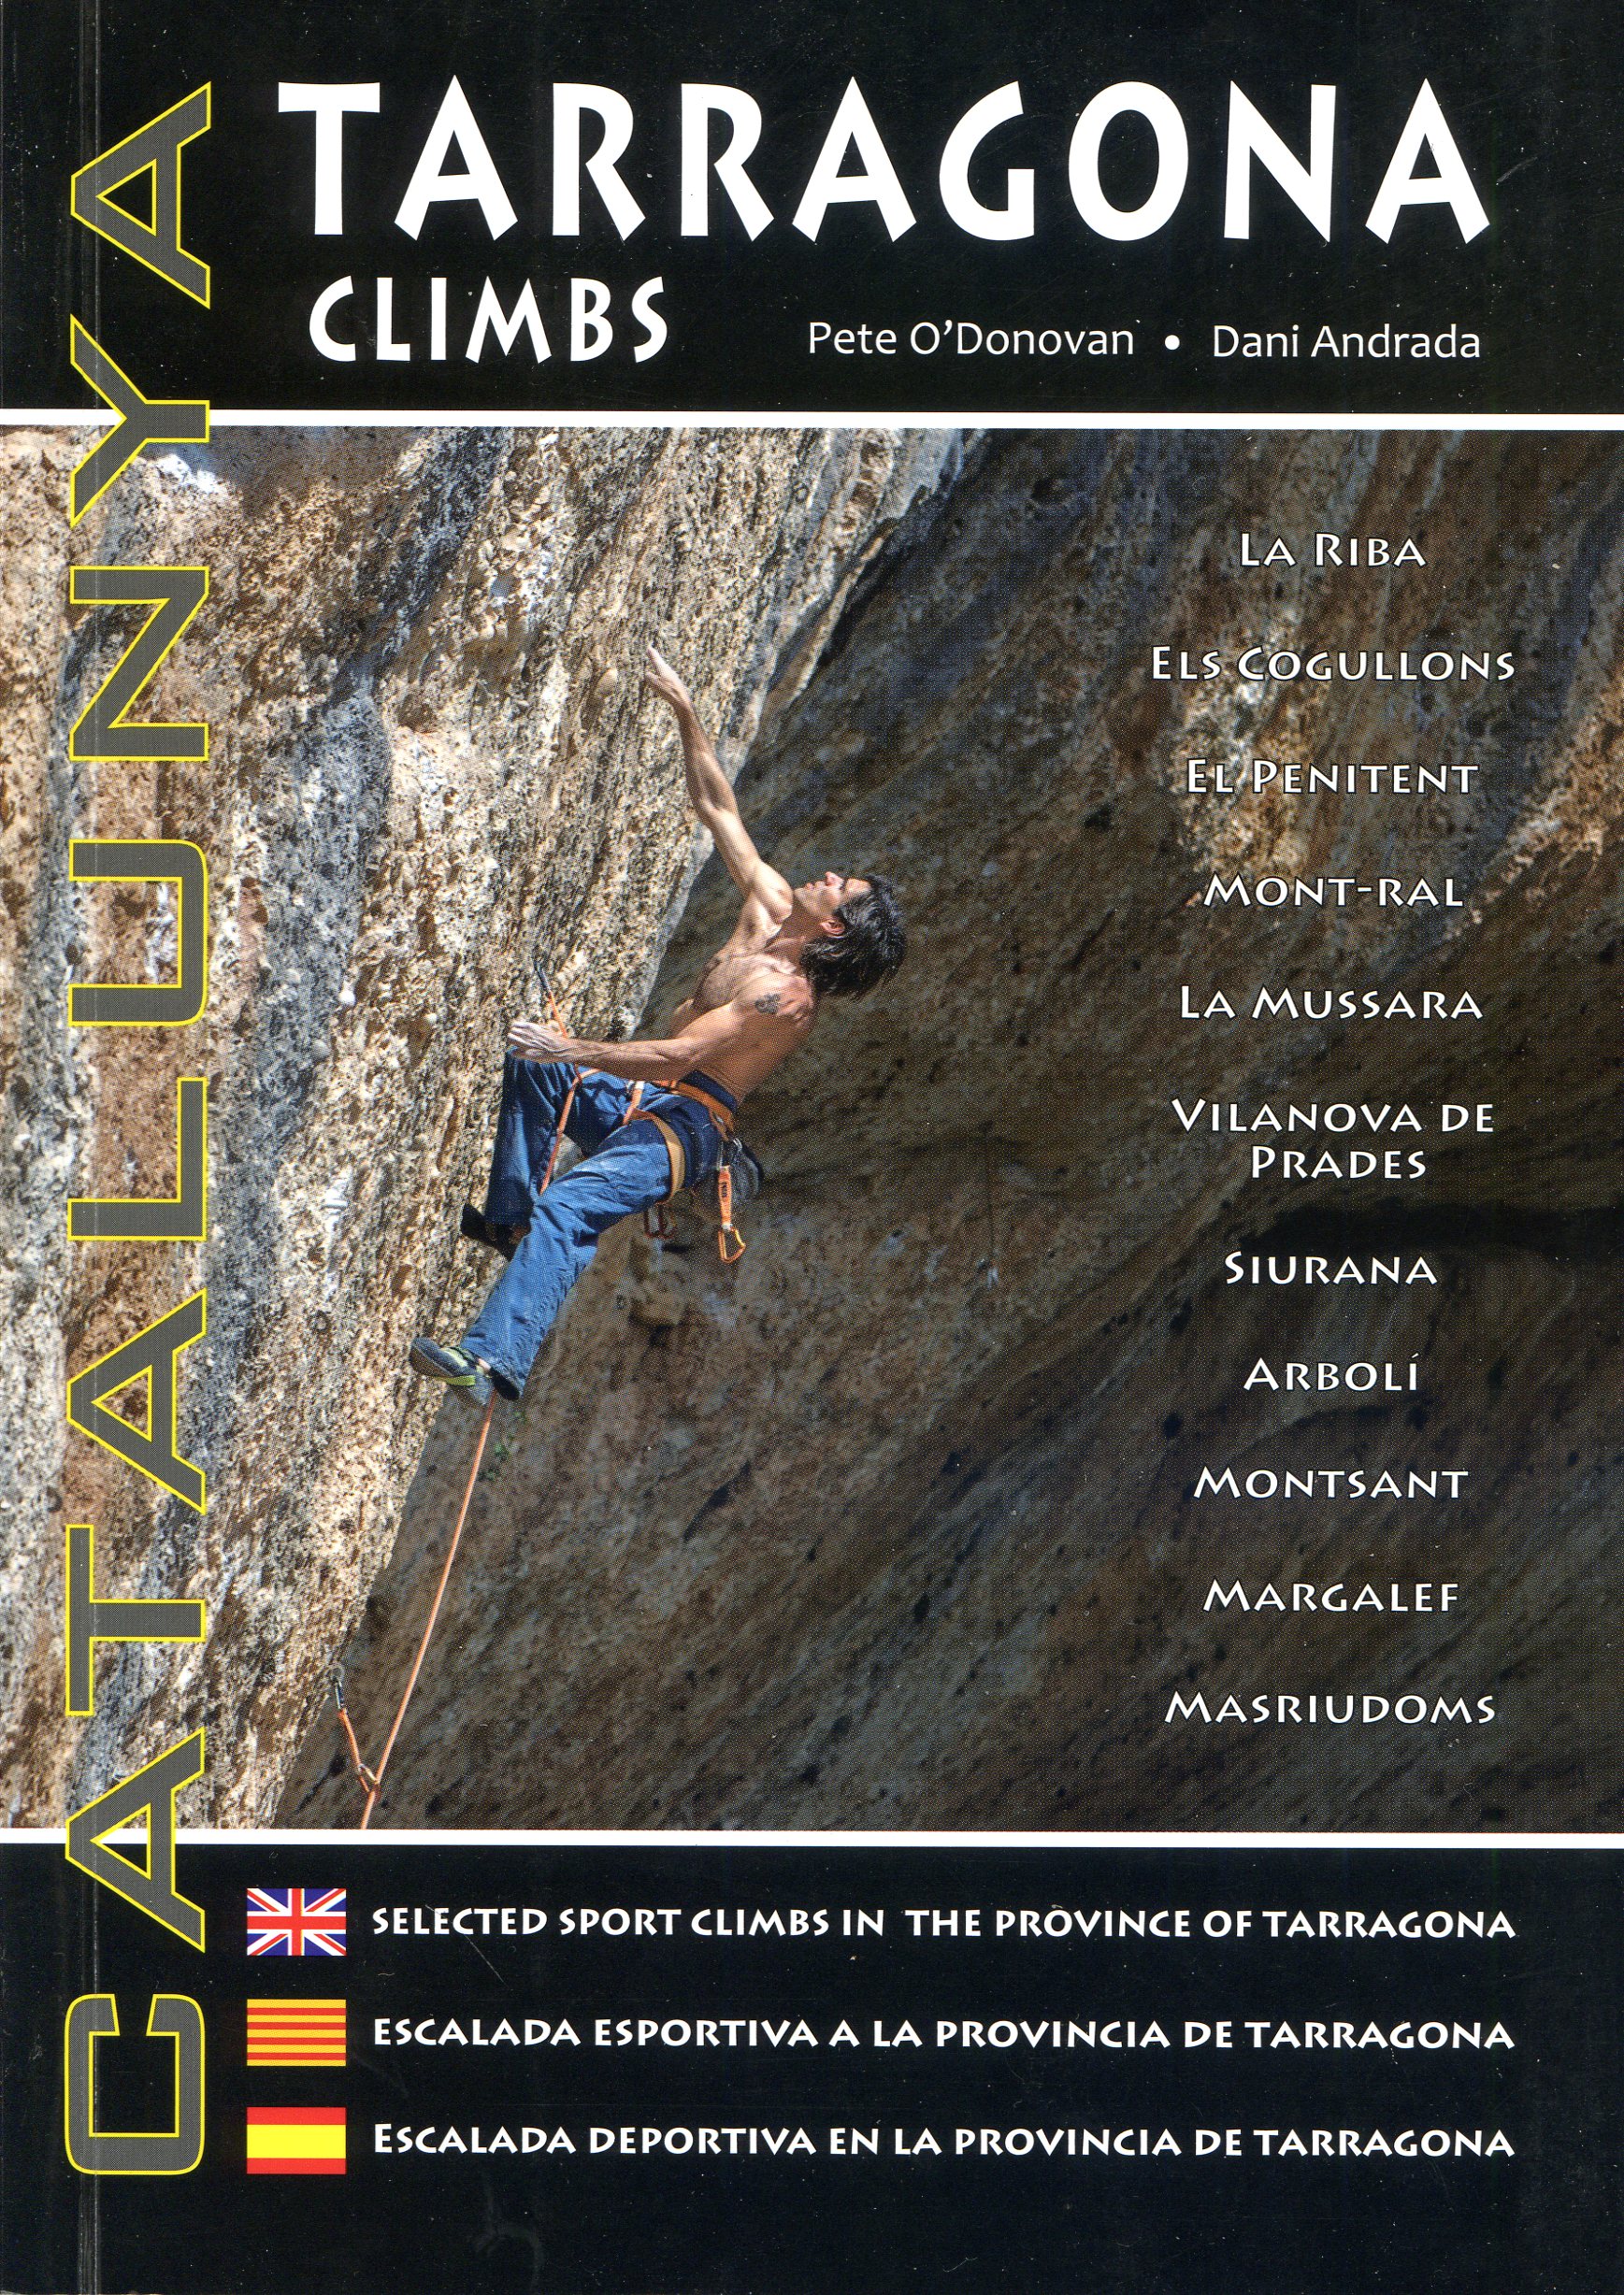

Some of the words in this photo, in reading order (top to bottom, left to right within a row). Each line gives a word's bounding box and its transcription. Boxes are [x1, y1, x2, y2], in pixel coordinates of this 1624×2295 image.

[278, 74, 1490, 244] TARRAGONA
[309, 275, 668, 364] CLIMBS
[810, 322, 897, 354] Pete
[910, 319, 1133, 355] O’Donovan
[1214, 325, 1298, 358] Dani
[1310, 323, 1480, 358] Andrada
[1242, 533, 1296, 567] LA
[1315, 533, 1426, 567] RIBA
[1153, 646, 1220, 680] ELS
[1238, 646, 1516, 681] COGULLONS
[1187, 758, 1236, 793] EL
[1254, 760, 1478, 794] PENITENT
[1203, 874, 1463, 907] MONT-RAL
[1181, 985, 1236, 1019] LA
[1252, 987, 1483, 1019] MUSSARA
[65, 82, 210, 2174] CATALUNYA
[1171, 1098, 1422, 1132] VILANOVA
[1442, 1104, 1493, 1132] DE
[1252, 1145, 1426, 1179] PRADES
[1225, 1251, 1438, 1284] SIURANA
[1243, 1353, 1419, 1392] ARBOLÍ
[1193, 1466, 1469, 1499] MONTSANT
[1203, 1579, 1459, 1612] MARGALEF
[1164, 1691, 1495, 1724] MASRIUDOMS
[372, 1907, 548, 1935] SELECTED
[559, 1908, 682, 1936] SPORT
[691, 1908, 829, 1936] CLIMBS
[843, 1909, 884, 1936] IN
[904, 1909, 981, 1937] THE
[996, 1909, 1190, 1938] PROVINCE
[1202, 1910, 1252, 1938] OF
[1262, 1910, 1516, 1939] TARRAGONA
[374, 2017, 582, 2046] ESCALADA
[595, 2018, 819, 2047] ESPORTIVA
[828, 2019, 860, 2047] A
[874, 2019, 923, 2047] LA
[937, 2020, 1171, 2048] PROVINCIA
[1185, 2021, 1233, 2048] DE
[1244, 2020, 1516, 2049] TARRAGONA
[375, 2123, 577, 2154] ESCALADA
[590, 2127, 817, 2156] DEPORTIVA
[830, 2128, 879, 2155] EN
[895, 2128, 942, 2156] LA
[956, 2128, 1182, 2157] PROVINCIA
[1195, 2129, 1243, 2156] DE
[1253, 2129, 1516, 2158] TARRAGONA
